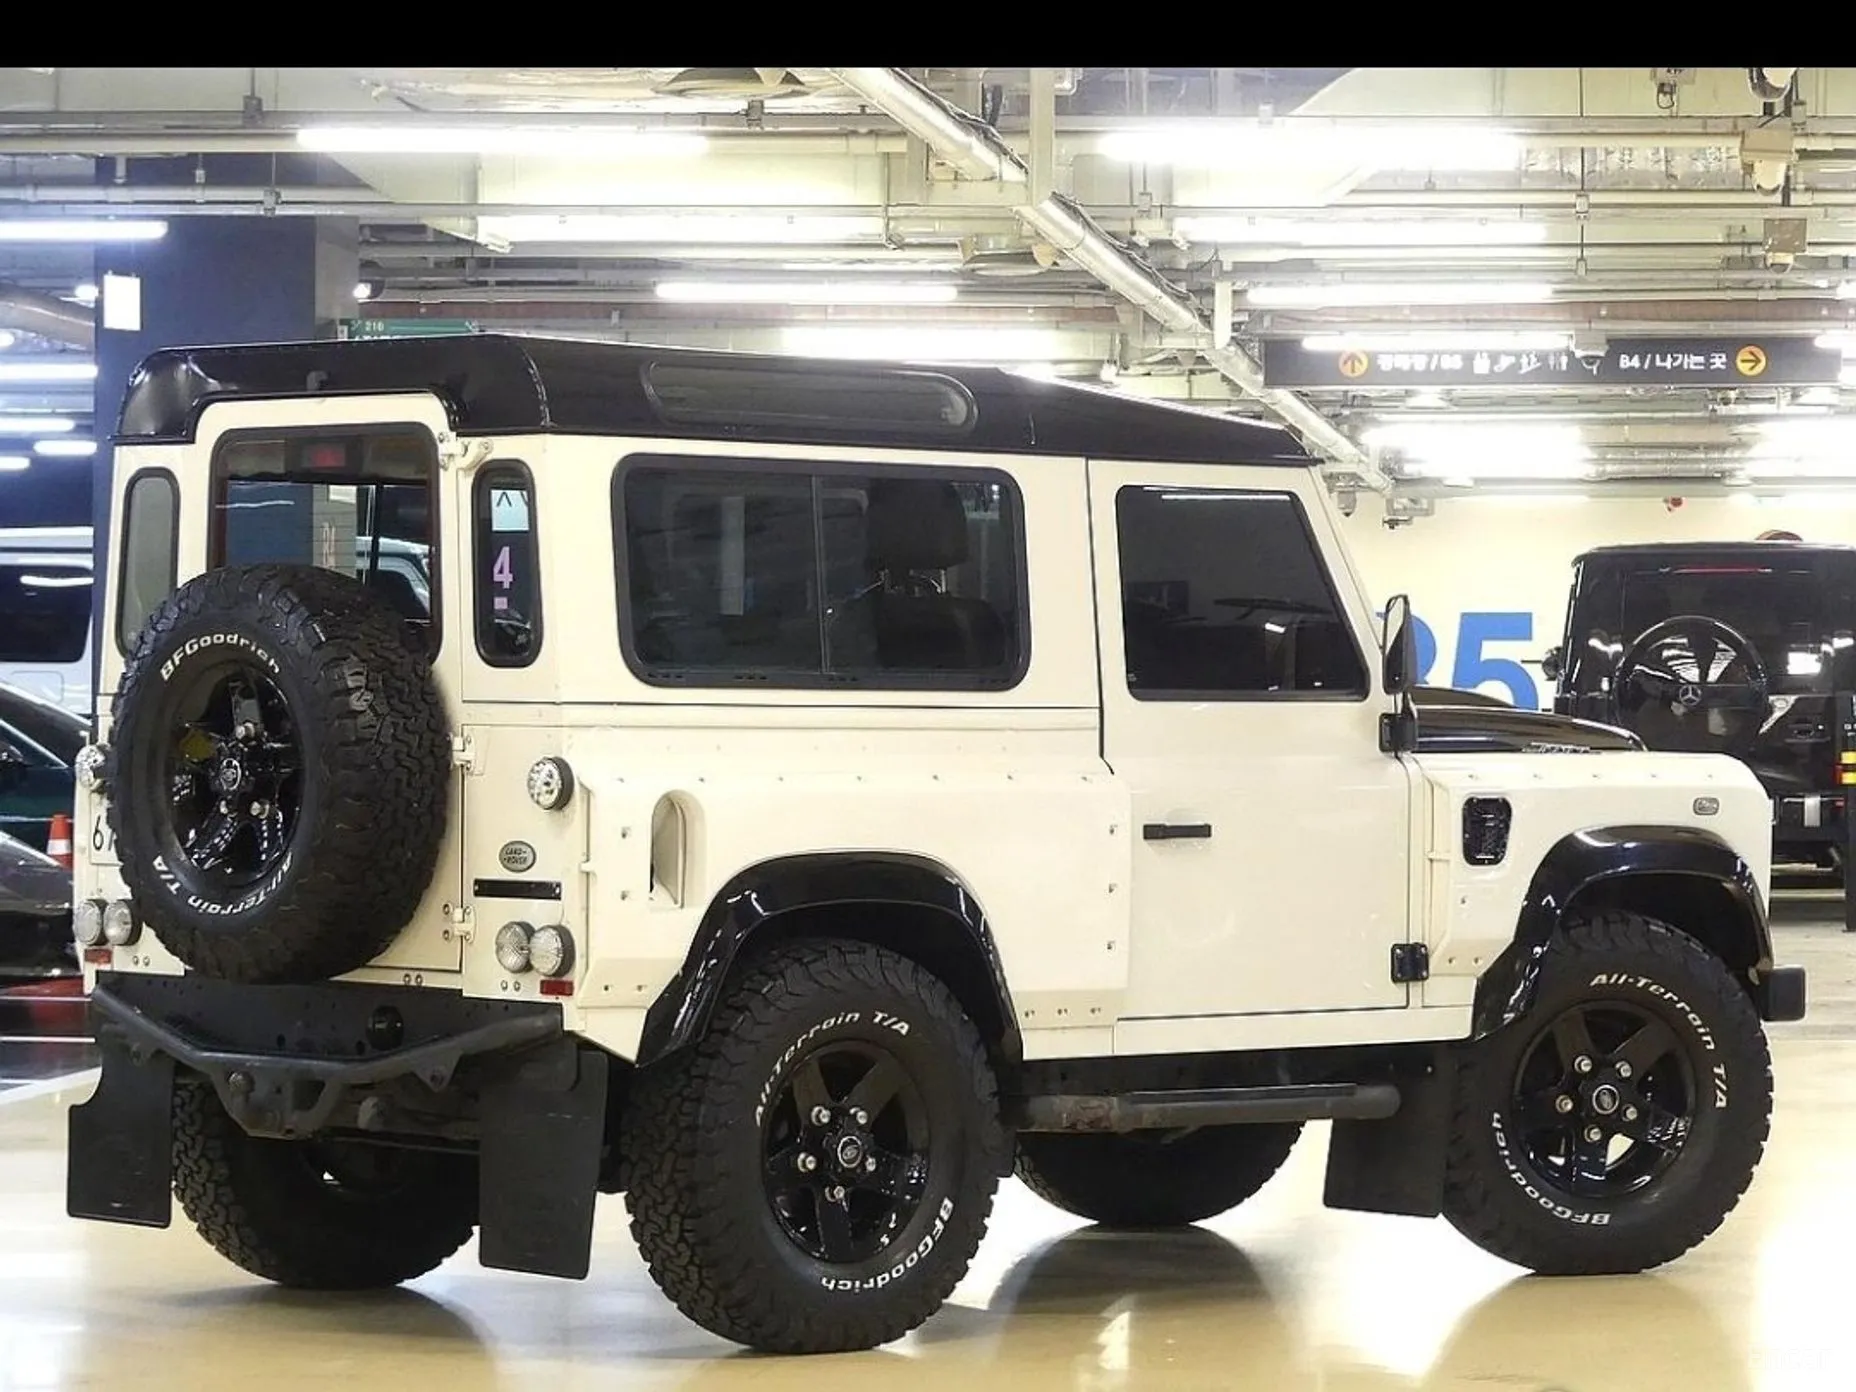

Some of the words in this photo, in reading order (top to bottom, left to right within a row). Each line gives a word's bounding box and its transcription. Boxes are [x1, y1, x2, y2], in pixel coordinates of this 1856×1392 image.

[1619, 353, 1641, 369] B4
[1655, 353, 1705, 370] 나가는
[160, 633, 280, 682] BFGoodrich
[152, 855, 181, 896] T/A
[187, 851, 292, 915] All-Terrain
[755, 1011, 861, 1127] All-Terrain
[873, 1010, 911, 1036] T/A
[1590, 973, 1715, 1050] All-Terrain
[1713, 1063, 1728, 1108] T/A
[1492, 1112, 1611, 1225] BFGoodrich
[821, 1197, 954, 1292] BFGoodrich
